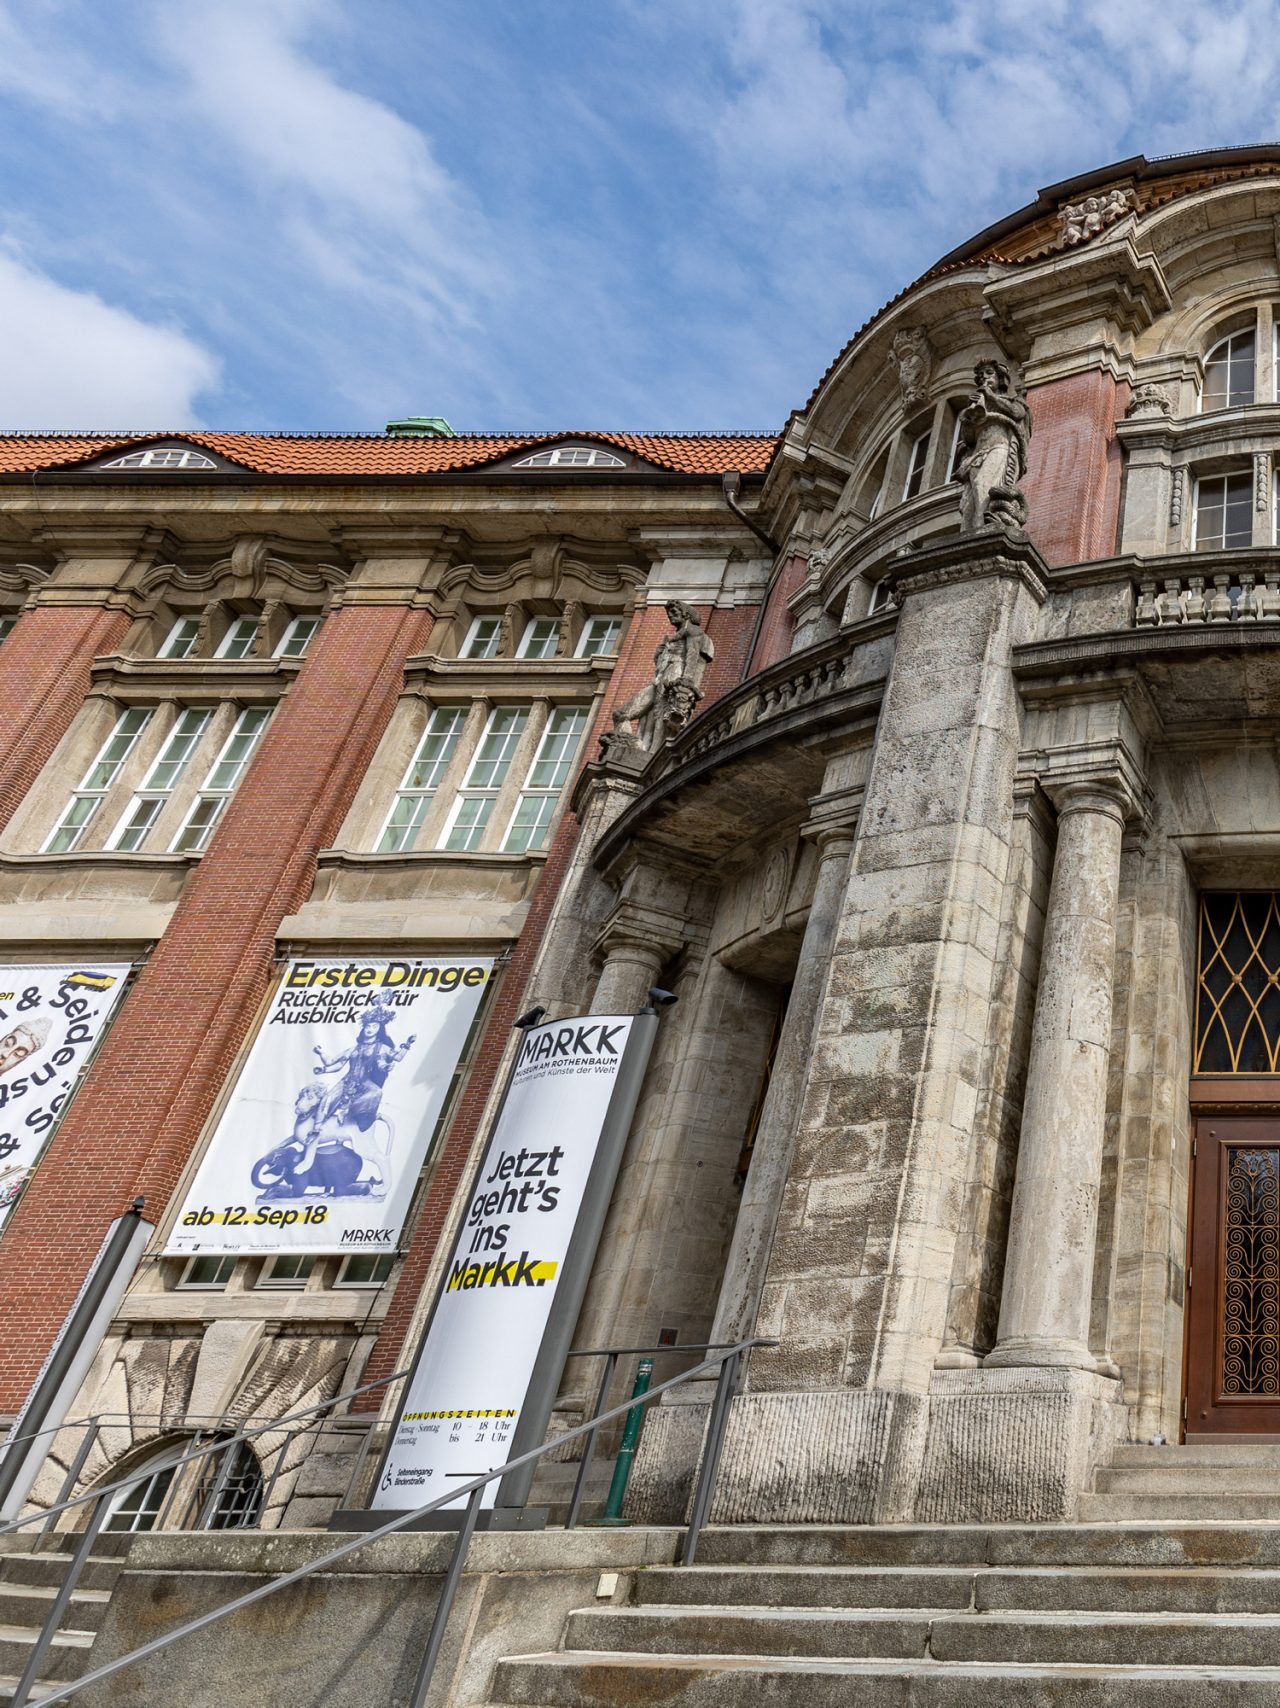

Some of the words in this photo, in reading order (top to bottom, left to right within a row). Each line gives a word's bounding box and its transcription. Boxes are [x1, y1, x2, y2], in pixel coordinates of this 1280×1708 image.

[285, 961, 376, 988] Erste
[380, 961, 484, 993] Dinge
[16, 986, 42, 1011] &
[277, 990, 378, 1007] Rückblick
[389, 990, 419, 1007] für
[269, 1007, 360, 1025] Ausblick
[519, 1025, 626, 1068] MARKK
[540, 1061, 551, 1070] AM
[552, 1058, 618, 1067] ROTHENBAUM
[548, 1066, 574, 1076] Künste
[576, 1066, 591, 1074] der
[594, 1066, 615, 1074] Welt
[487, 1146, 564, 1183] Jetzt
[468, 1180, 561, 1226] geht’s
[183, 1206, 214, 1226] ab
[222, 1206, 249, 1226] 12.
[253, 1206, 299, 1229] Sep
[302, 1205, 328, 1225] 18
[341, 1229, 395, 1242] MARKK
[469, 1220, 511, 1253] ins
[445, 1251, 546, 1293] Markk.
[402, 1409, 515, 1421] ÖFFNUNGSZEITEN
[452, 1422, 462, 1431] 10
[478, 1421, 489, 1430] 18
[495, 1420, 511, 1430] Uhr
[449, 1433, 460, 1443] bis
[475, 1433, 485, 1443] 21
[491, 1432, 508, 1442] Uhr
